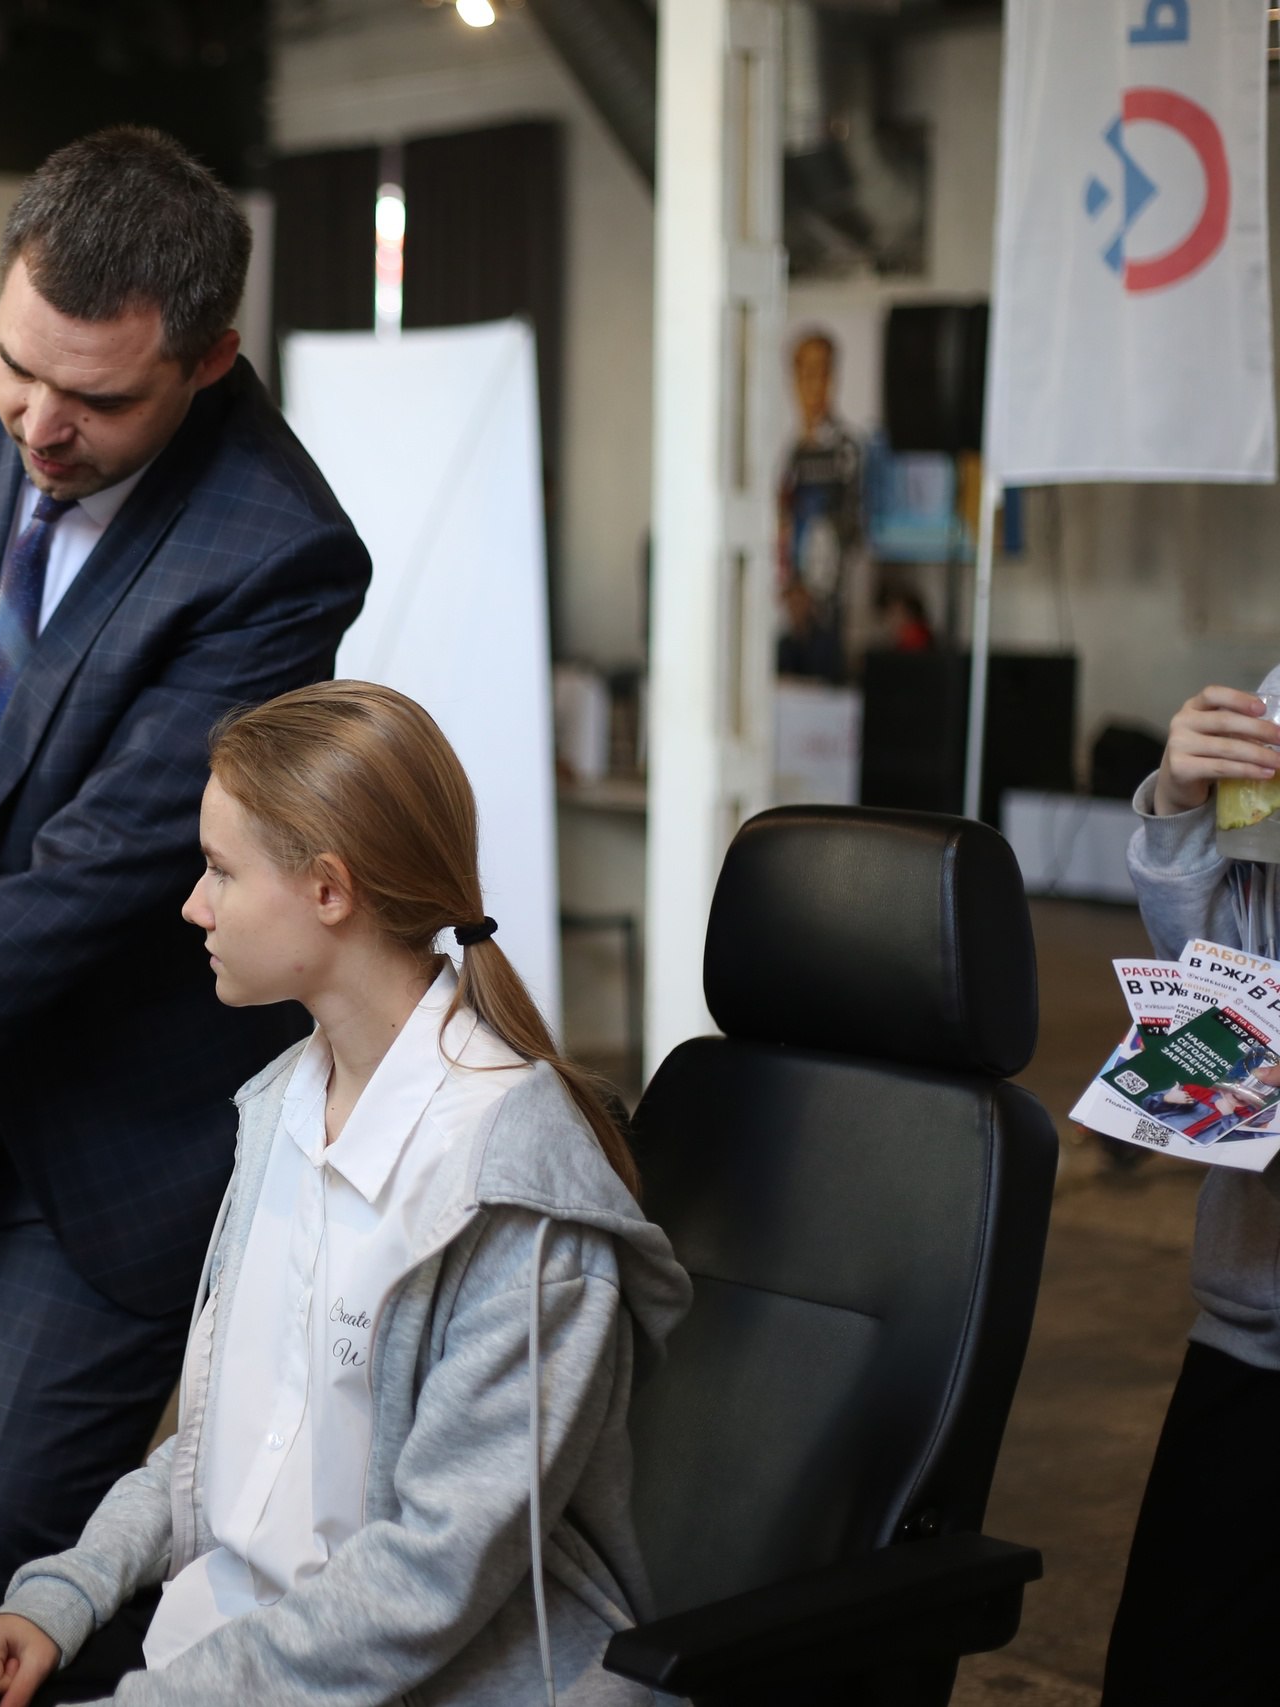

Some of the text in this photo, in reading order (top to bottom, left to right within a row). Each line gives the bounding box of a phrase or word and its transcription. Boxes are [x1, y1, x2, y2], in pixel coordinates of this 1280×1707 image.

[1189, 957, 1202, 968] В
[1193, 943, 1272, 972] РАБОТА
[1122, 967, 1182, 979] РАБОТА
[1126, 980, 1144, 995] В
[1180, 989, 1219, 1006] 8 800
[1248, 985, 1268, 1000] В
[1160, 1046, 1198, 1076] ЗАВТРА!
[1169, 1041, 1220, 1081] УВЕРЕННОЕ
[1177, 1037, 1217, 1069] СЕГОДНЯ
[1184, 1032, 1233, 1071] НАДЕЖНОЕ
[329, 1296, 372, 1330] Create
